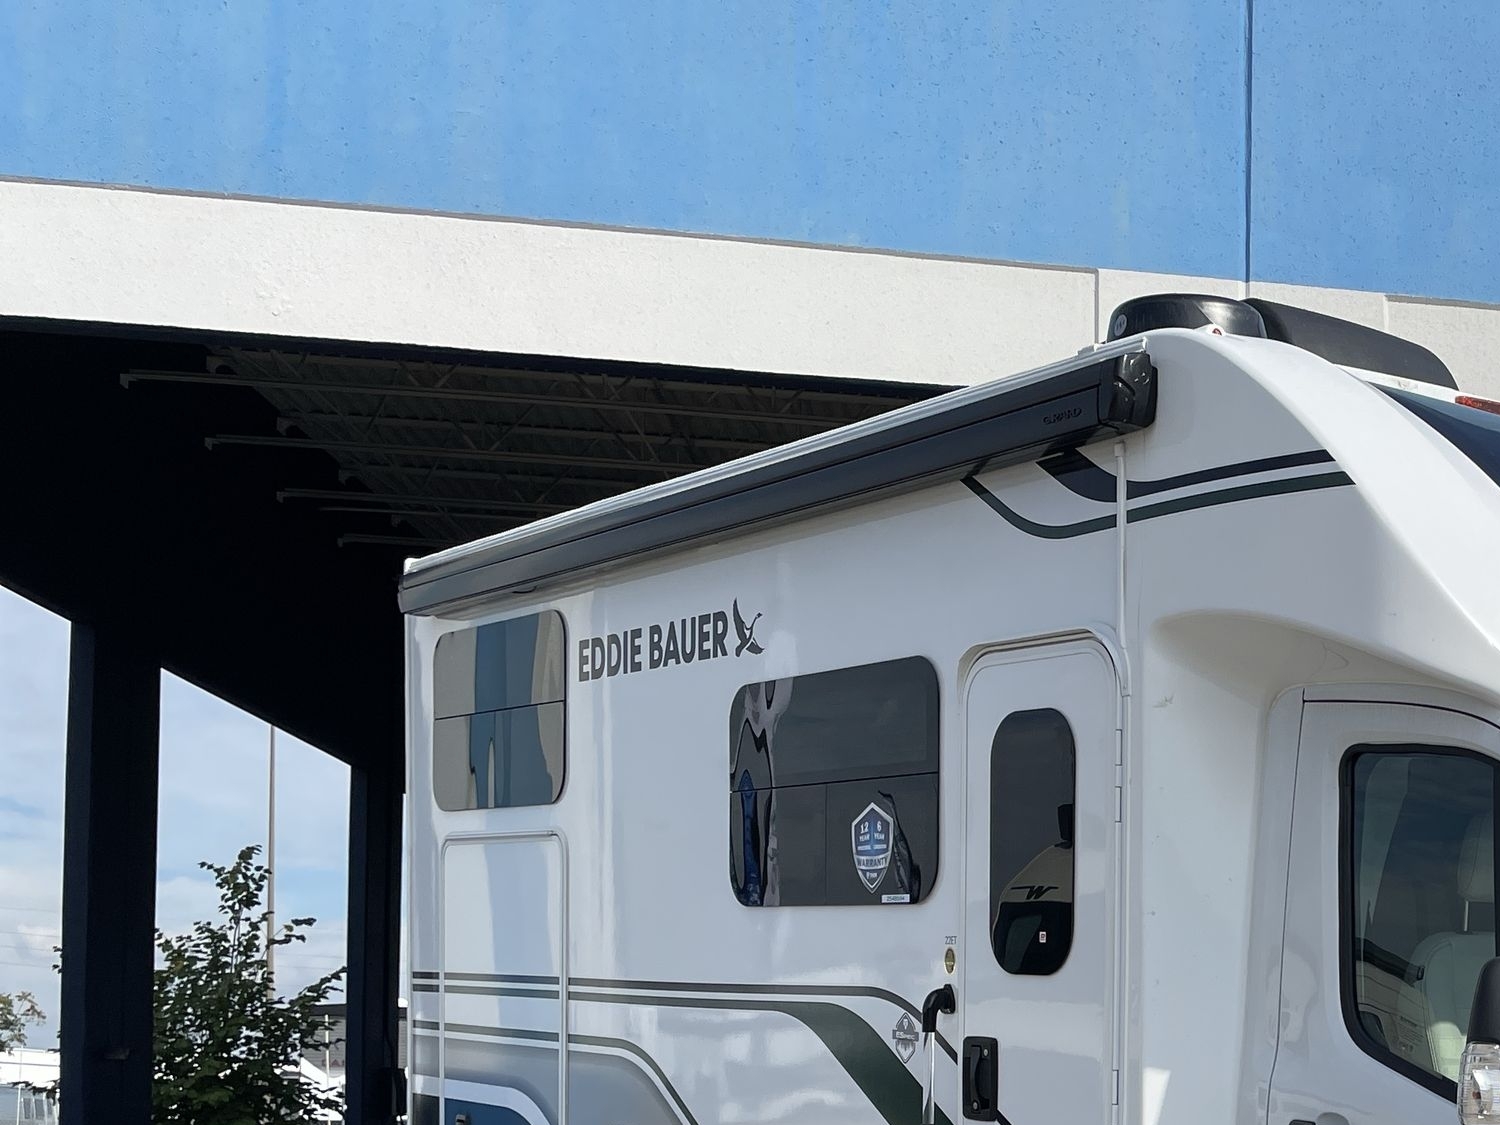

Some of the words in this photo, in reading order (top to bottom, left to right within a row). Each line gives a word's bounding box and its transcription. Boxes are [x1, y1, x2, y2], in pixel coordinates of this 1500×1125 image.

[579, 628, 642, 682] EDDIE
[649, 611, 728, 669] BAUER
[860, 821, 869, 834] 12
[876, 820, 882, 832] 6
[857, 857, 887, 867] WARRANTY
